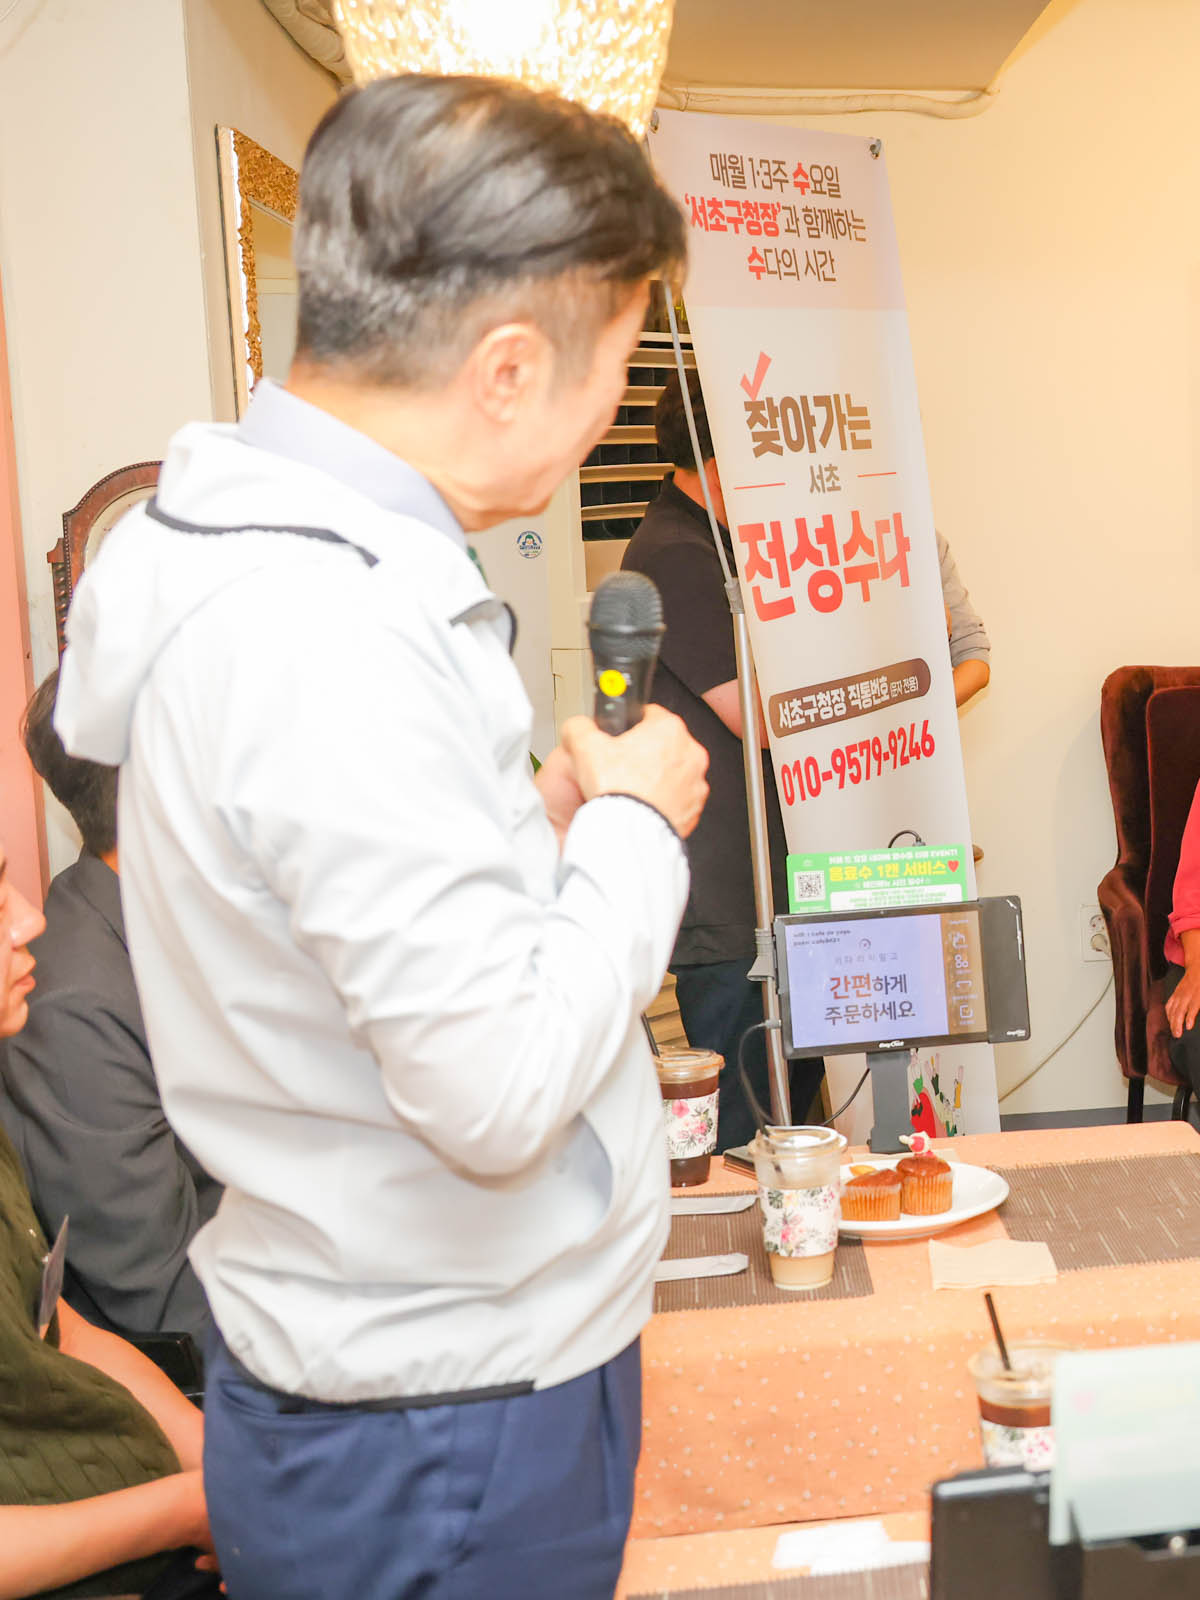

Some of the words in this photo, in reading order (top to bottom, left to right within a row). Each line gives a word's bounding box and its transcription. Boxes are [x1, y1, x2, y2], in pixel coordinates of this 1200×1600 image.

[709, 152, 747, 190] 매월
[792, 162, 842, 199] 수요일
[801, 205, 867, 242] 함께하는
[747, 246, 800, 281] 수다의
[804, 249, 837, 282] 시간
[743, 393, 873, 458] 찾아가는
[809, 463, 842, 494] 서초
[737, 510, 911, 622] 전성수다
[778, 687, 847, 729] 서초구청장
[847, 676, 891, 710] 직통번호
[781, 719, 936, 806] 010-9579-9246
[903, 860, 947, 877] 서비스
[829, 973, 908, 1000] 간편하게
